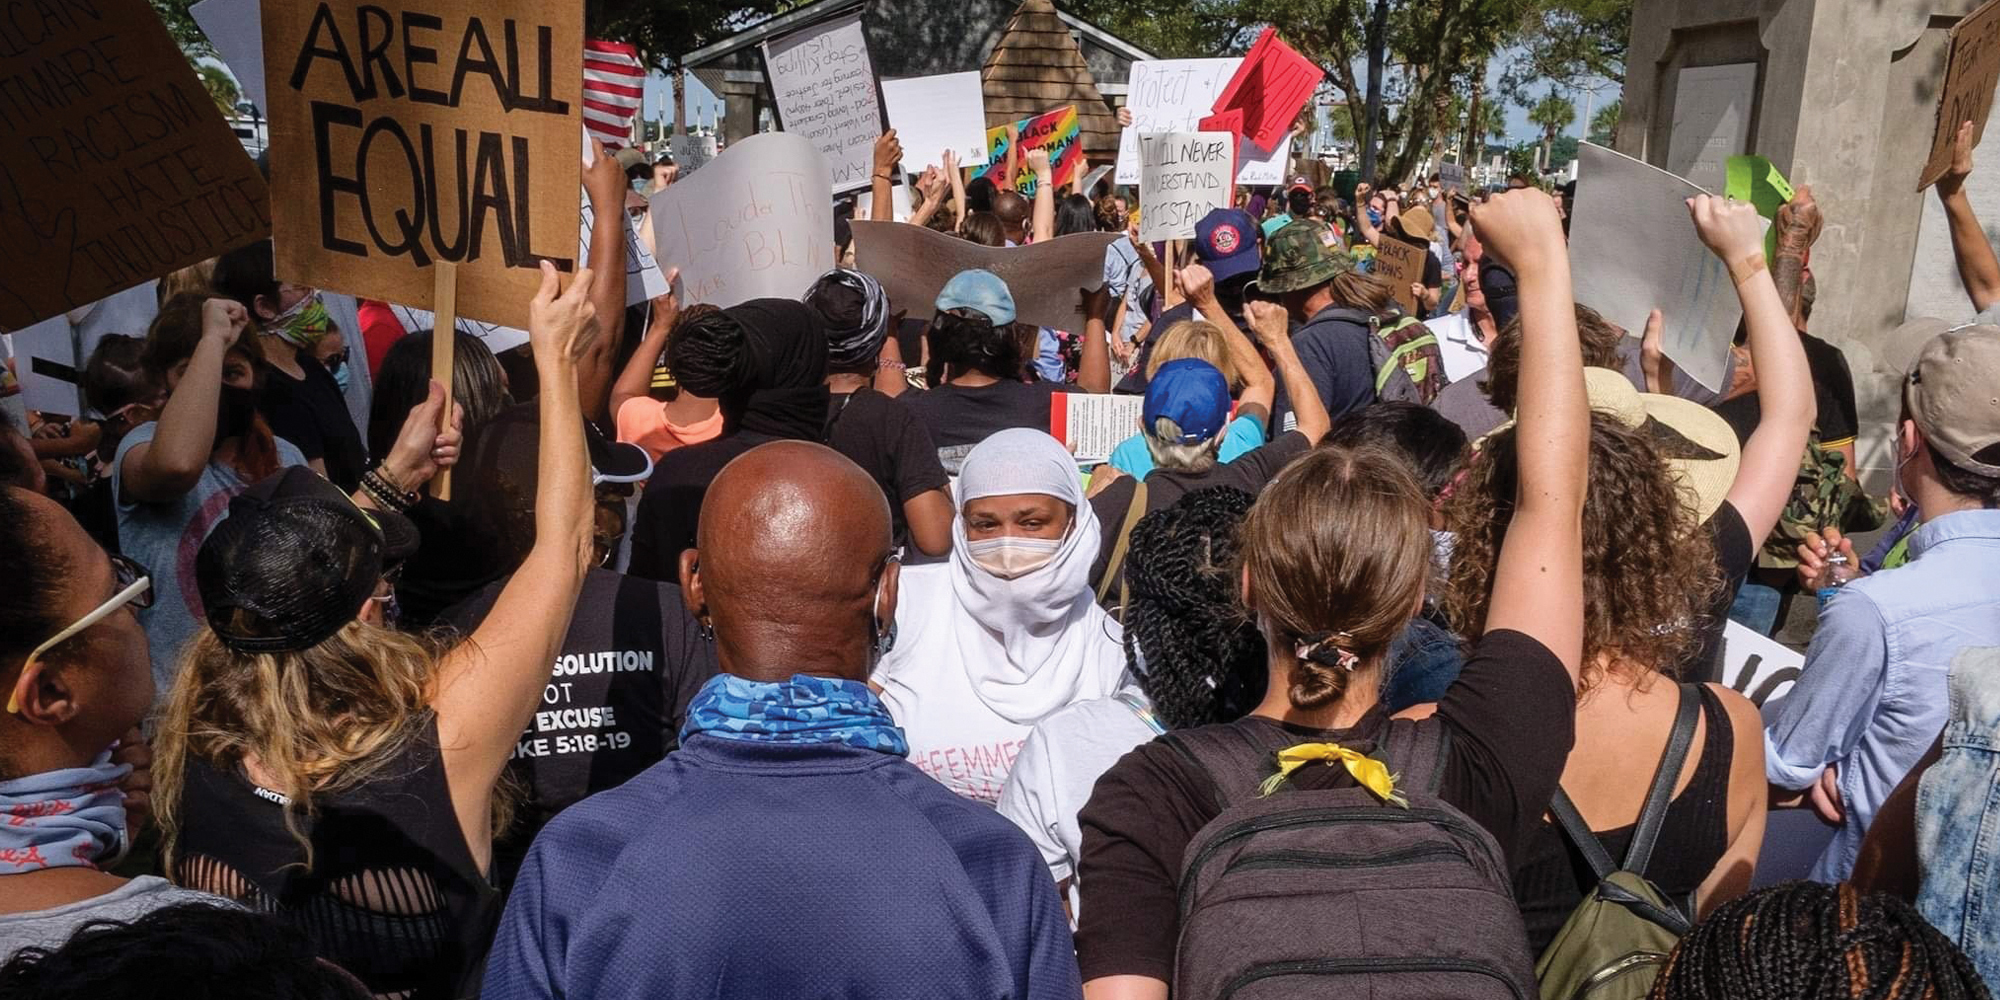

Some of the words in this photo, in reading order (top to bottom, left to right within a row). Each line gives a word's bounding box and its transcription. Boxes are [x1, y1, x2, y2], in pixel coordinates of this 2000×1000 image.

[775, 54, 821, 76] Killing
[821, 44, 861, 67] Stop
[1134, 62, 1200, 109] Protect
[29, 82, 204, 183] RACISM
[1180, 138, 1227, 164] NEVER
[93, 144, 226, 217] HATE
[831, 161, 867, 184] AM
[311, 101, 574, 273] EQUAL
[75, 176, 272, 290] INJUSTICE
[552, 650, 654, 677] SOLUTION
[543, 682, 573, 705] OT
[535, 706, 617, 733] EXCUSE
[555, 731, 632, 755] 5:18-19
